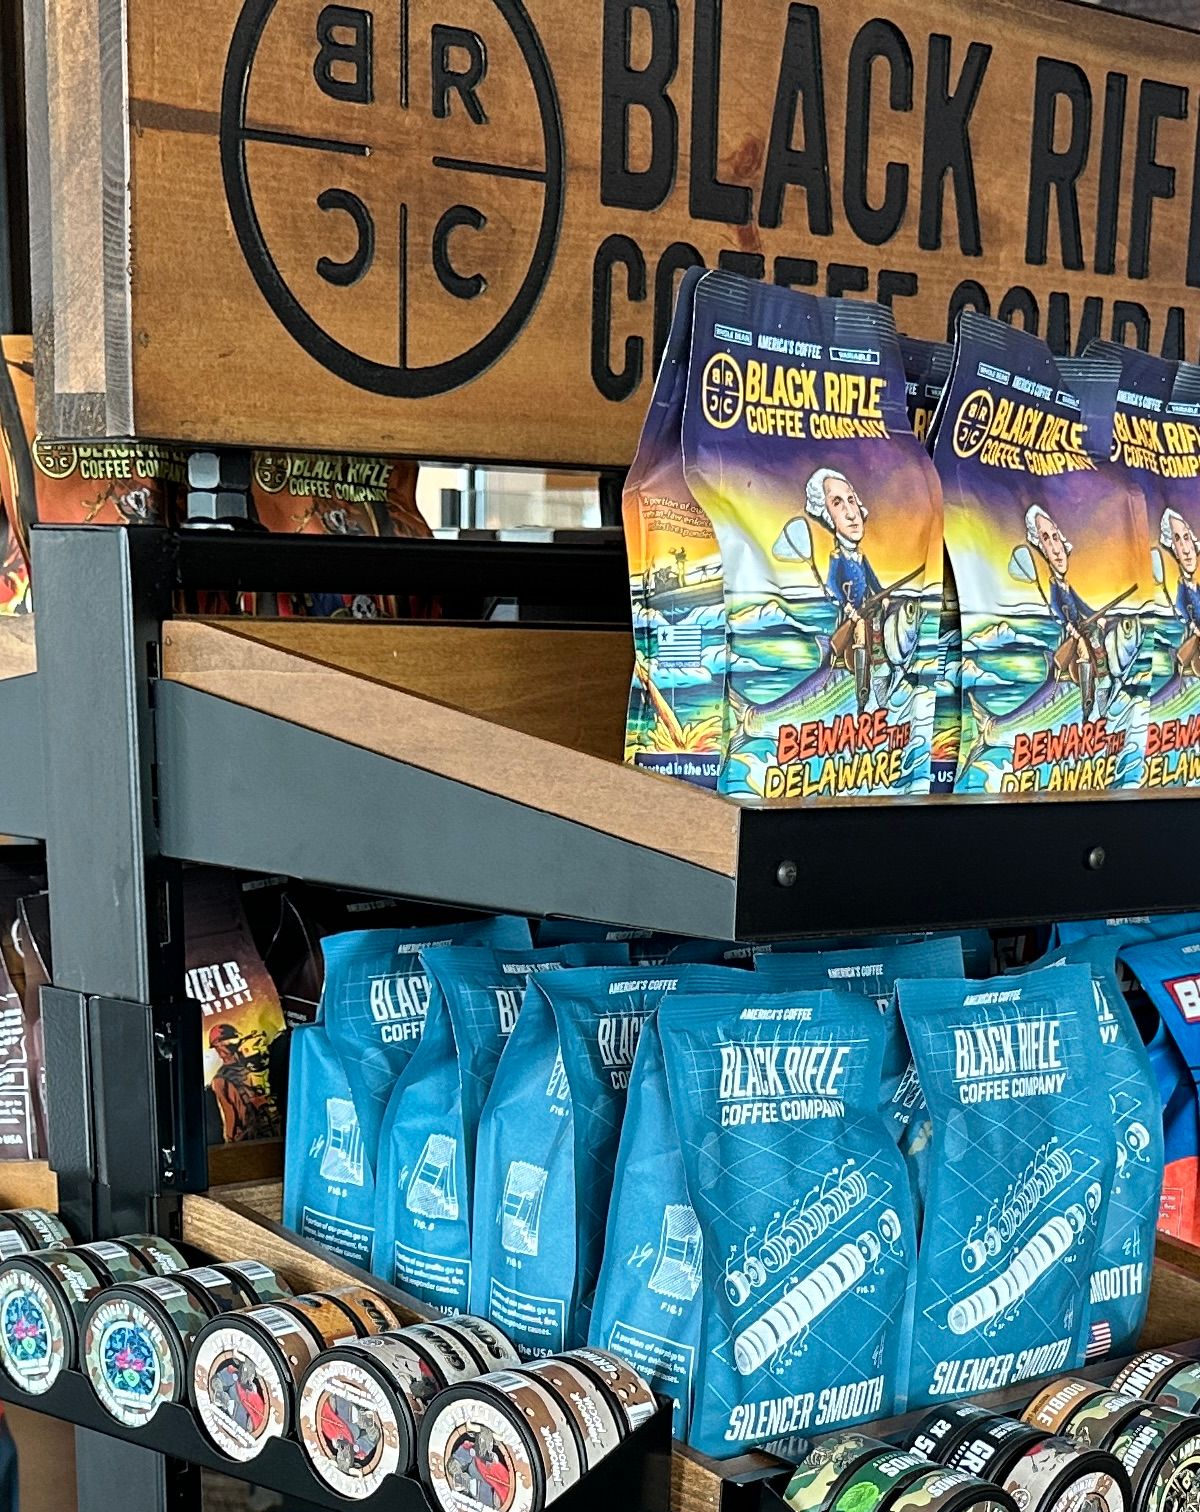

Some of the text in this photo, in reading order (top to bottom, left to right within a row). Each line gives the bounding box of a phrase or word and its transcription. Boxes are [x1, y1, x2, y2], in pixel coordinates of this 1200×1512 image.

[600, 0, 1200, 288] BLACK RIF
[758, 334, 822, 360] AMERICA'S COFFEE
[745, 360, 884, 418] BLACK RIFLE
[746, 405, 806, 439] COFFEE
[809, 413, 891, 440] COMPANY
[990, 398, 1087, 455] BLACK RIFLE
[1113, 411, 1200, 455] BLACK RIF
[81, 461, 132, 480] COFFEE
[980, 438, 1098, 477] COFFEE COMPANY
[1123, 444, 1200, 478] COFFEE COMP
[289, 479, 333, 500] COFFEE
[349, 462, 395, 488] RIFLE
[777, 708, 912, 766] BEWARE THE
[1013, 717, 1127, 771] BEWARE THE
[683, 762, 702, 776] the
[765, 748, 903, 799] DELAWARE
[936, 771, 954, 784] US
[1001, 754, 1117, 793] DELAWARE
[609, 979, 679, 995] AMERICA'S COFFEE
[827, 964, 884, 979] AMERICA'S COFFEE
[201, 988, 254, 1016] MPANY
[740, 1008, 813, 1021] AMERICA'S COFFEE
[963, 989, 1022, 1007] AMERICA'S COFFEE
[381, 1021, 425, 1043] COFF
[954, 1020, 1063, 1078] BLACK RIFLE
[718, 1046, 849, 1098] BLACK RIFLE
[959, 1073, 1067, 1104] COFFEE COMPANY
[721, 1098, 846, 1127] COFFEE COMPANY
[1090, 1262, 1143, 1304] MOOTH
[440, 1304, 460, 1317] USA
[518, 1343, 554, 1359] the USA
[929, 1335, 1073, 1397] SILENCER SMOOTH
[724, 1375, 886, 1442] SILENCER SMOOTH
[1037, 1382, 1087, 1427] DOUBLE
